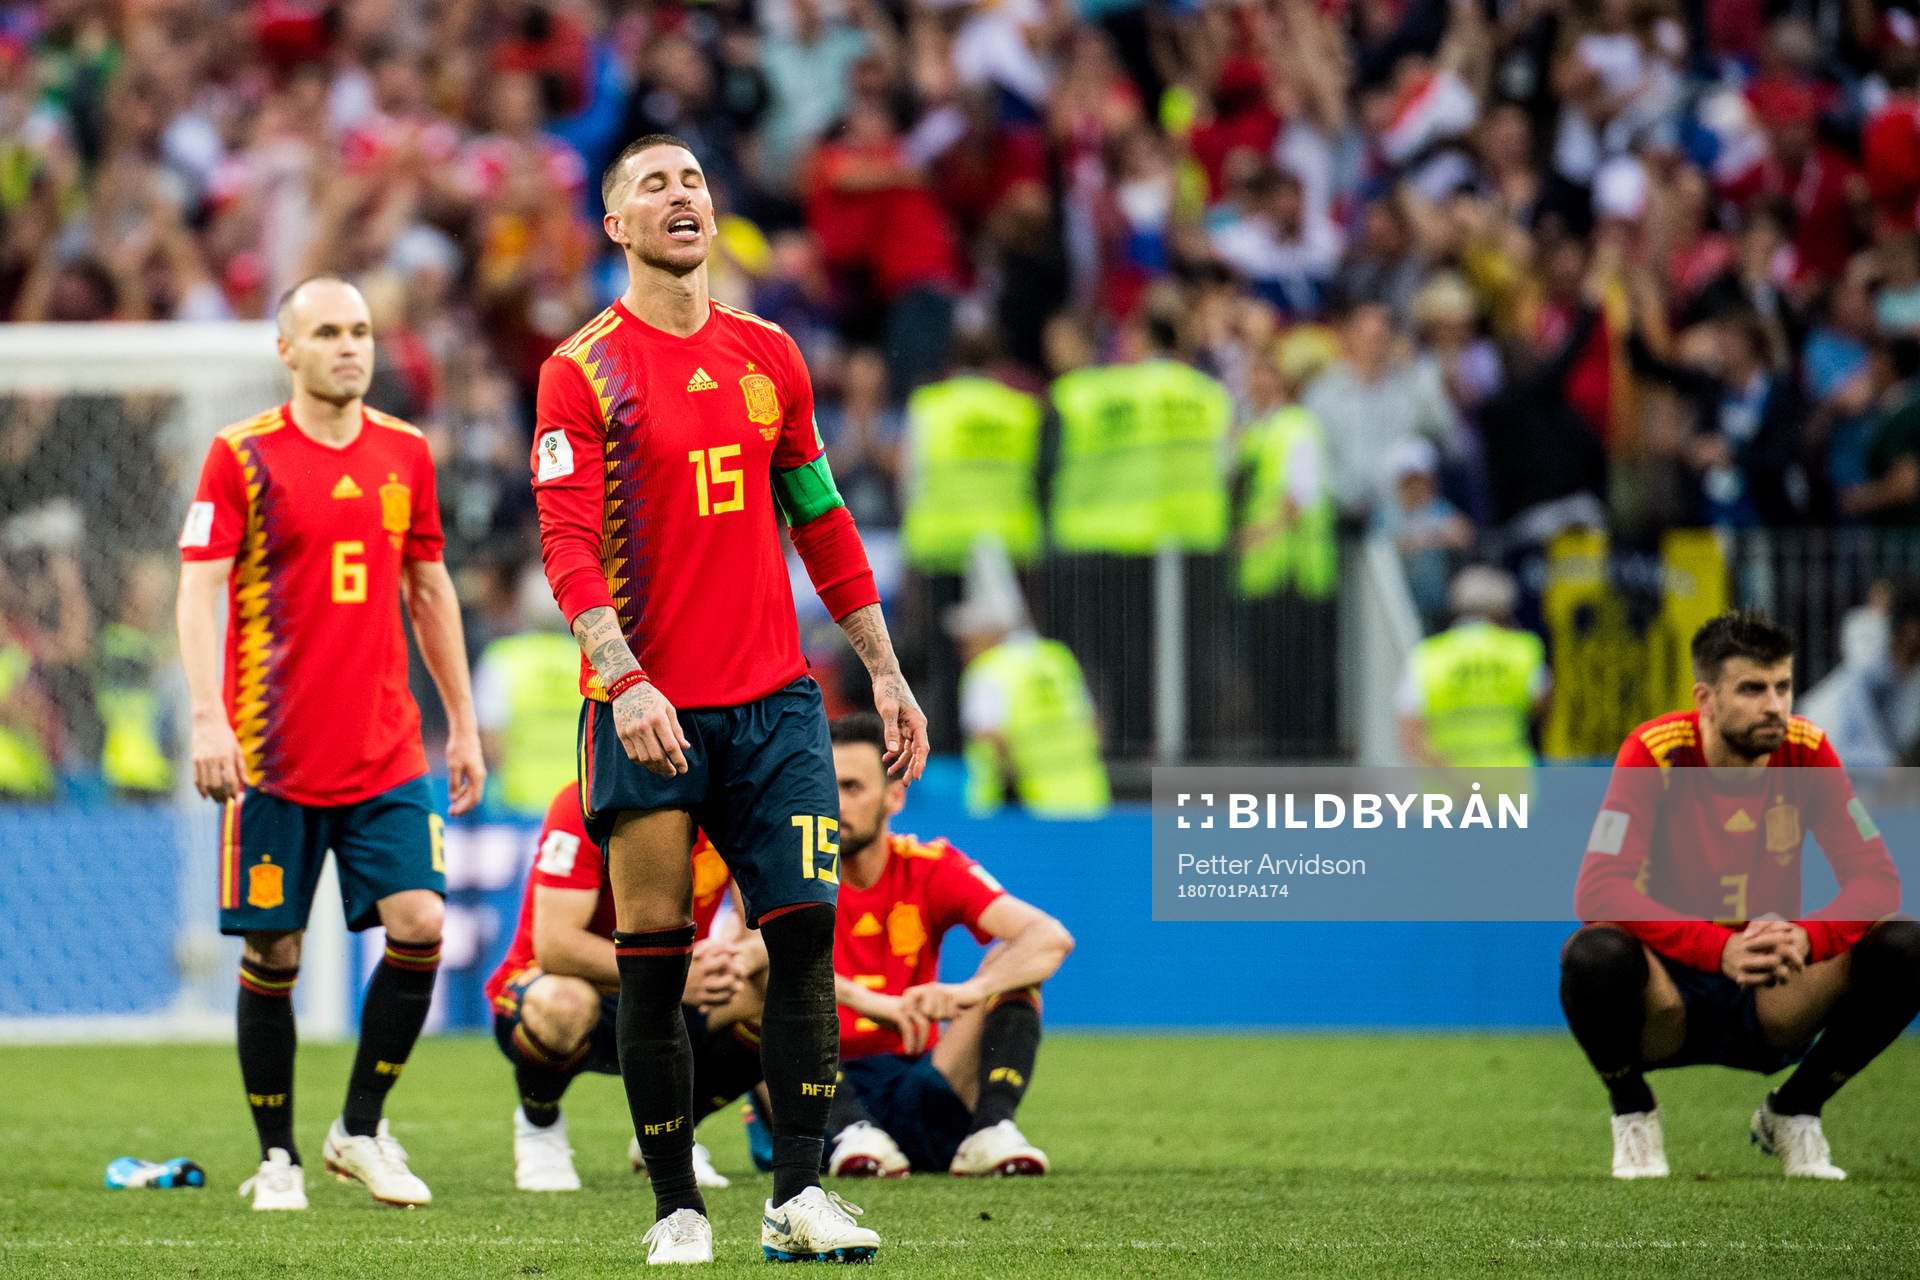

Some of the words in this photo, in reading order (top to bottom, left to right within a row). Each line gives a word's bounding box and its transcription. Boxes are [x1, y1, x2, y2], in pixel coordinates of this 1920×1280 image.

[687, 381, 719, 392] adidas
[688, 443, 745, 517] 15
[331, 541, 367, 603] 6
[791, 815, 840, 885] 15
[1711, 873, 1749, 926] 3
